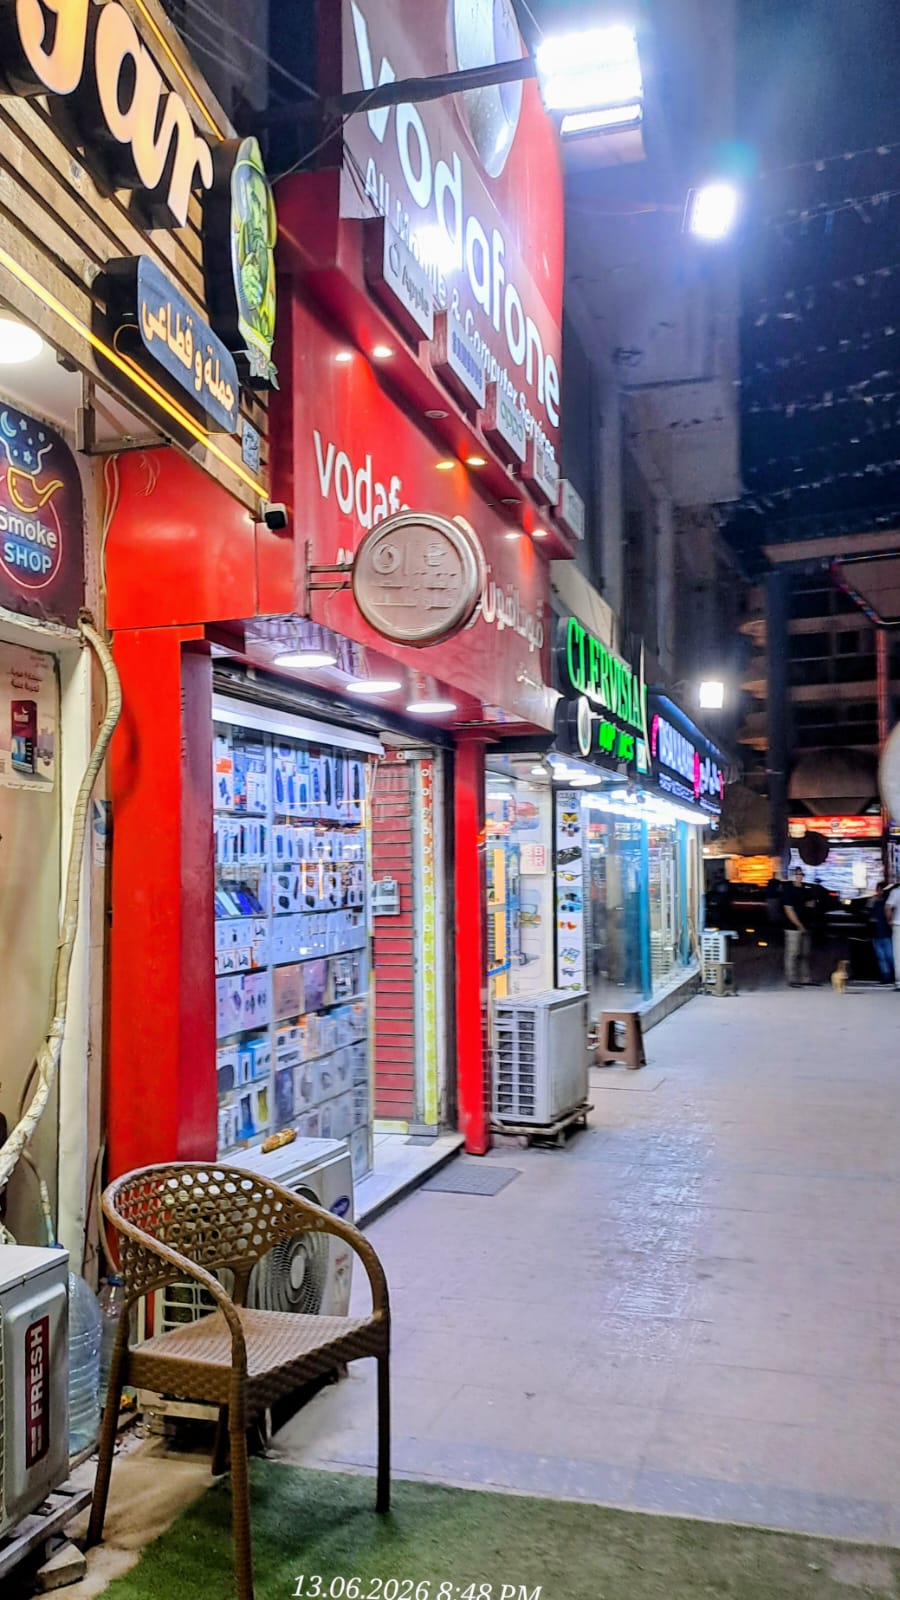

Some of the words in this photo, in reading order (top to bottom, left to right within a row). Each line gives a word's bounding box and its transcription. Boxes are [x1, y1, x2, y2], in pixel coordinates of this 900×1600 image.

[0, 506, 58, 549] Smoke
[4, 542, 52, 574] SHOP
[30, 1324, 44, 1420] FRESH
